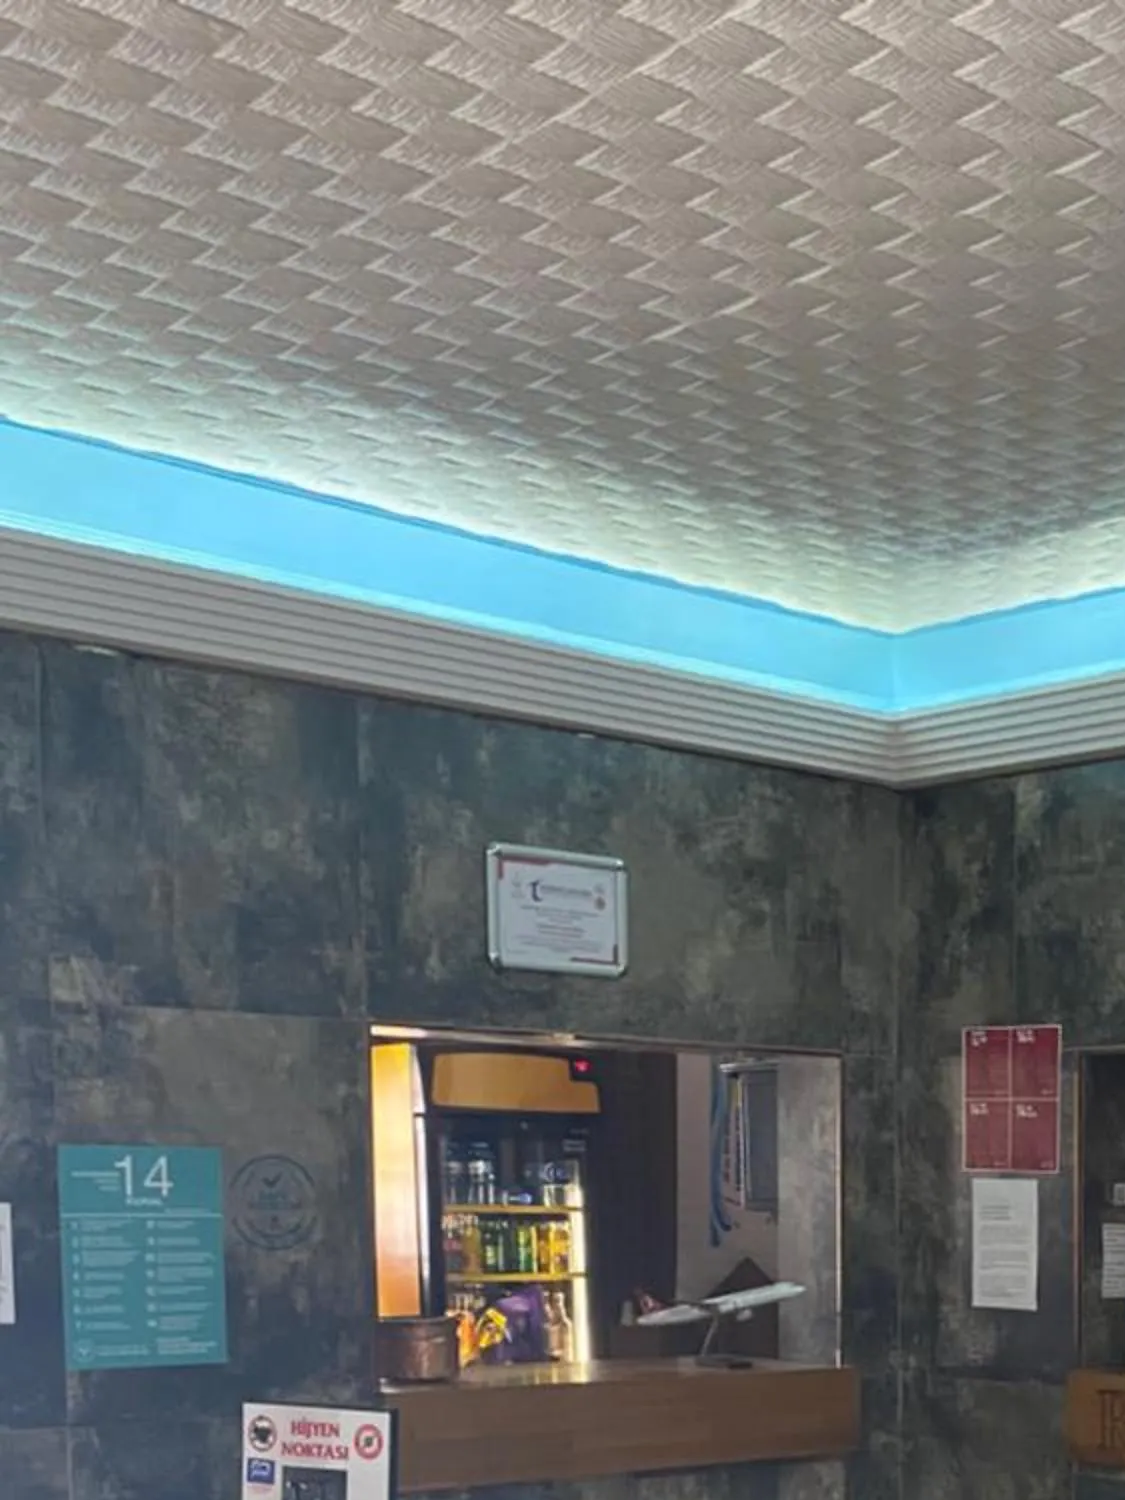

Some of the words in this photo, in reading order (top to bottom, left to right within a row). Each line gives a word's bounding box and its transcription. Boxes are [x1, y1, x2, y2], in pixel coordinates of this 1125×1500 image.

[113, 1153, 175, 1198] 14
[291, 1416, 341, 1439] HİJYEN
[280, 1442, 350, 1462] NOKTASI
